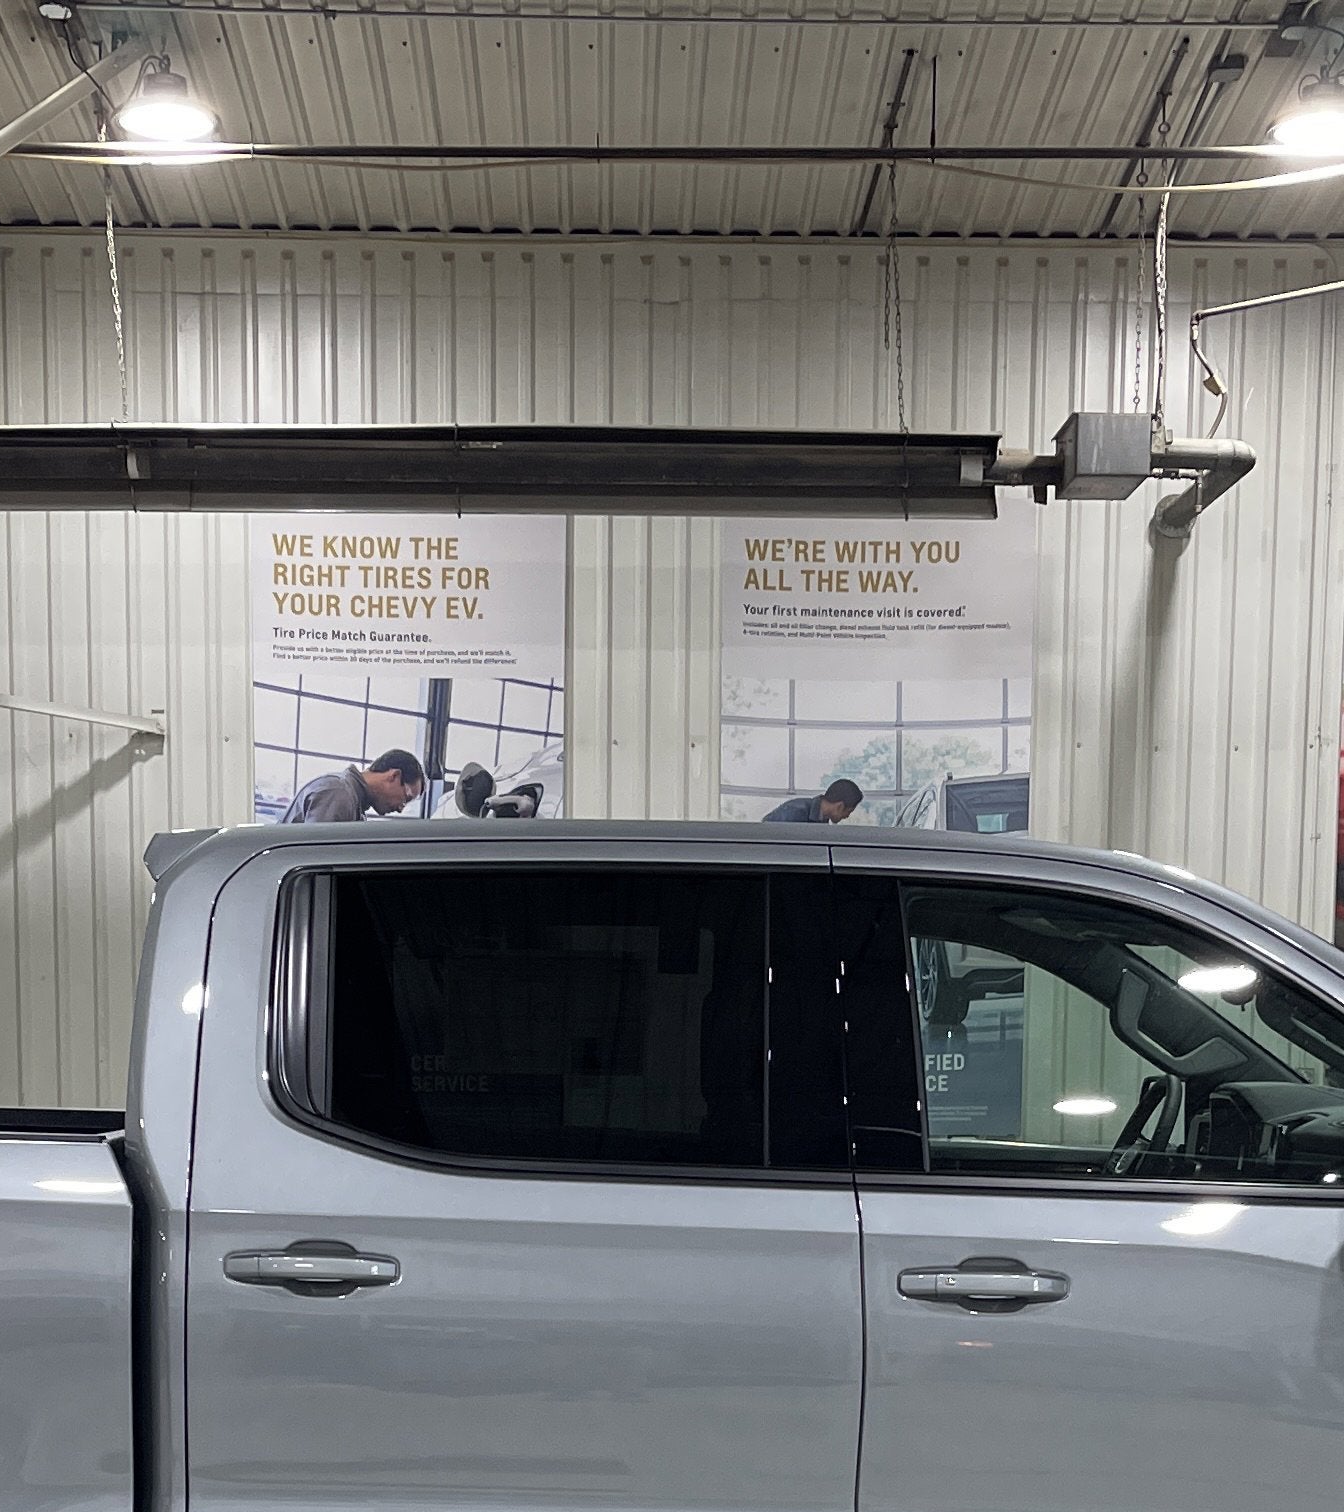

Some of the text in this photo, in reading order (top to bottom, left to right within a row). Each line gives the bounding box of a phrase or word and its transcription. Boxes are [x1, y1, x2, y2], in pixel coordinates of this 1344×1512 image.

[272, 533, 459, 560] WE KNOW THE
[745, 538, 960, 564] WE'RE WITH YOU
[273, 563, 490, 590] RIGHT TIRES FOR
[744, 568, 919, 593] ALL THE WAY.
[272, 592, 483, 619] YOUR CHEVY EV.
[743, 603, 769, 616] Your
[773, 605, 797, 617] first
[801, 606, 873, 618] maintenance
[877, 606, 901, 618] visit
[905, 607, 913, 618] is
[273, 627, 432, 643] Tire Price Match Guarantee.
